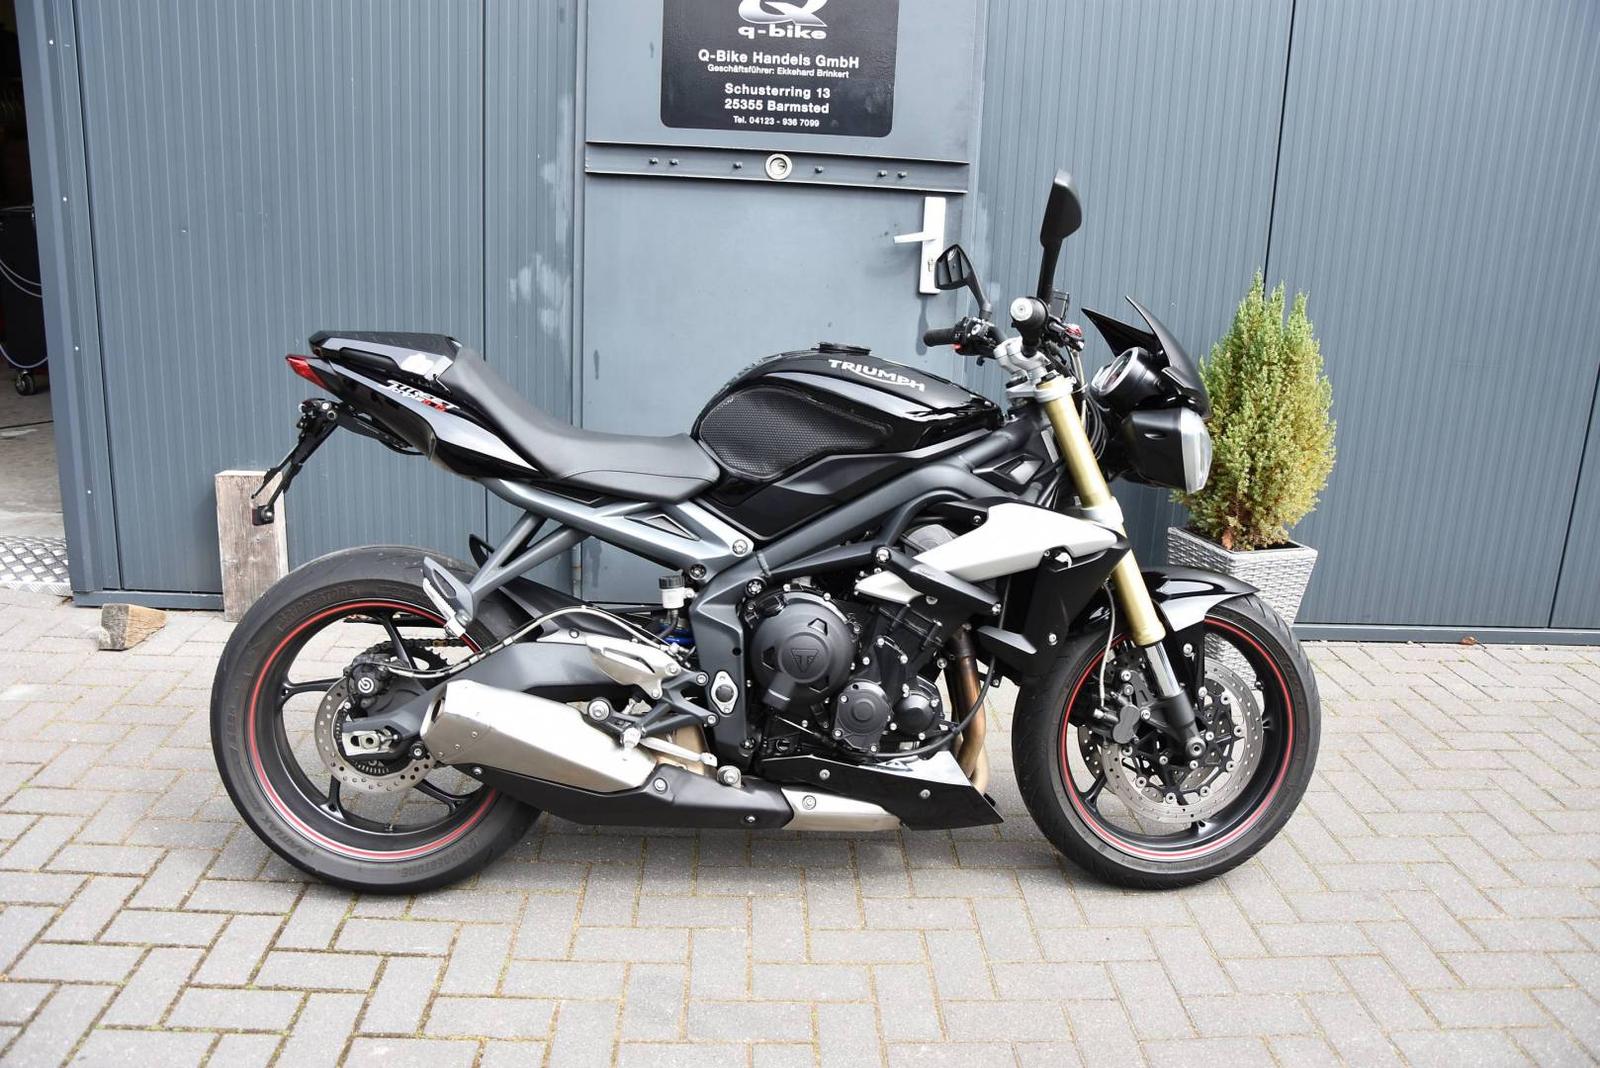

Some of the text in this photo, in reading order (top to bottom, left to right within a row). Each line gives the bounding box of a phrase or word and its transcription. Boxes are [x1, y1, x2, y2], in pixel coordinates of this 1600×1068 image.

[738, 24, 827, 39] q-bike
[698, 49, 859, 69] Q-Bike Handels GmbH
[777, 67, 815, 77] Ekkehard
[817, 68, 850, 79] Brinkert
[725, 83, 831, 100] Schusterring 13
[725, 98, 763, 111] 25355
[733, 115, 747, 124] Tel.
[748, 116, 775, 126] 04123
[828, 359, 925, 392] TRIUMPH
